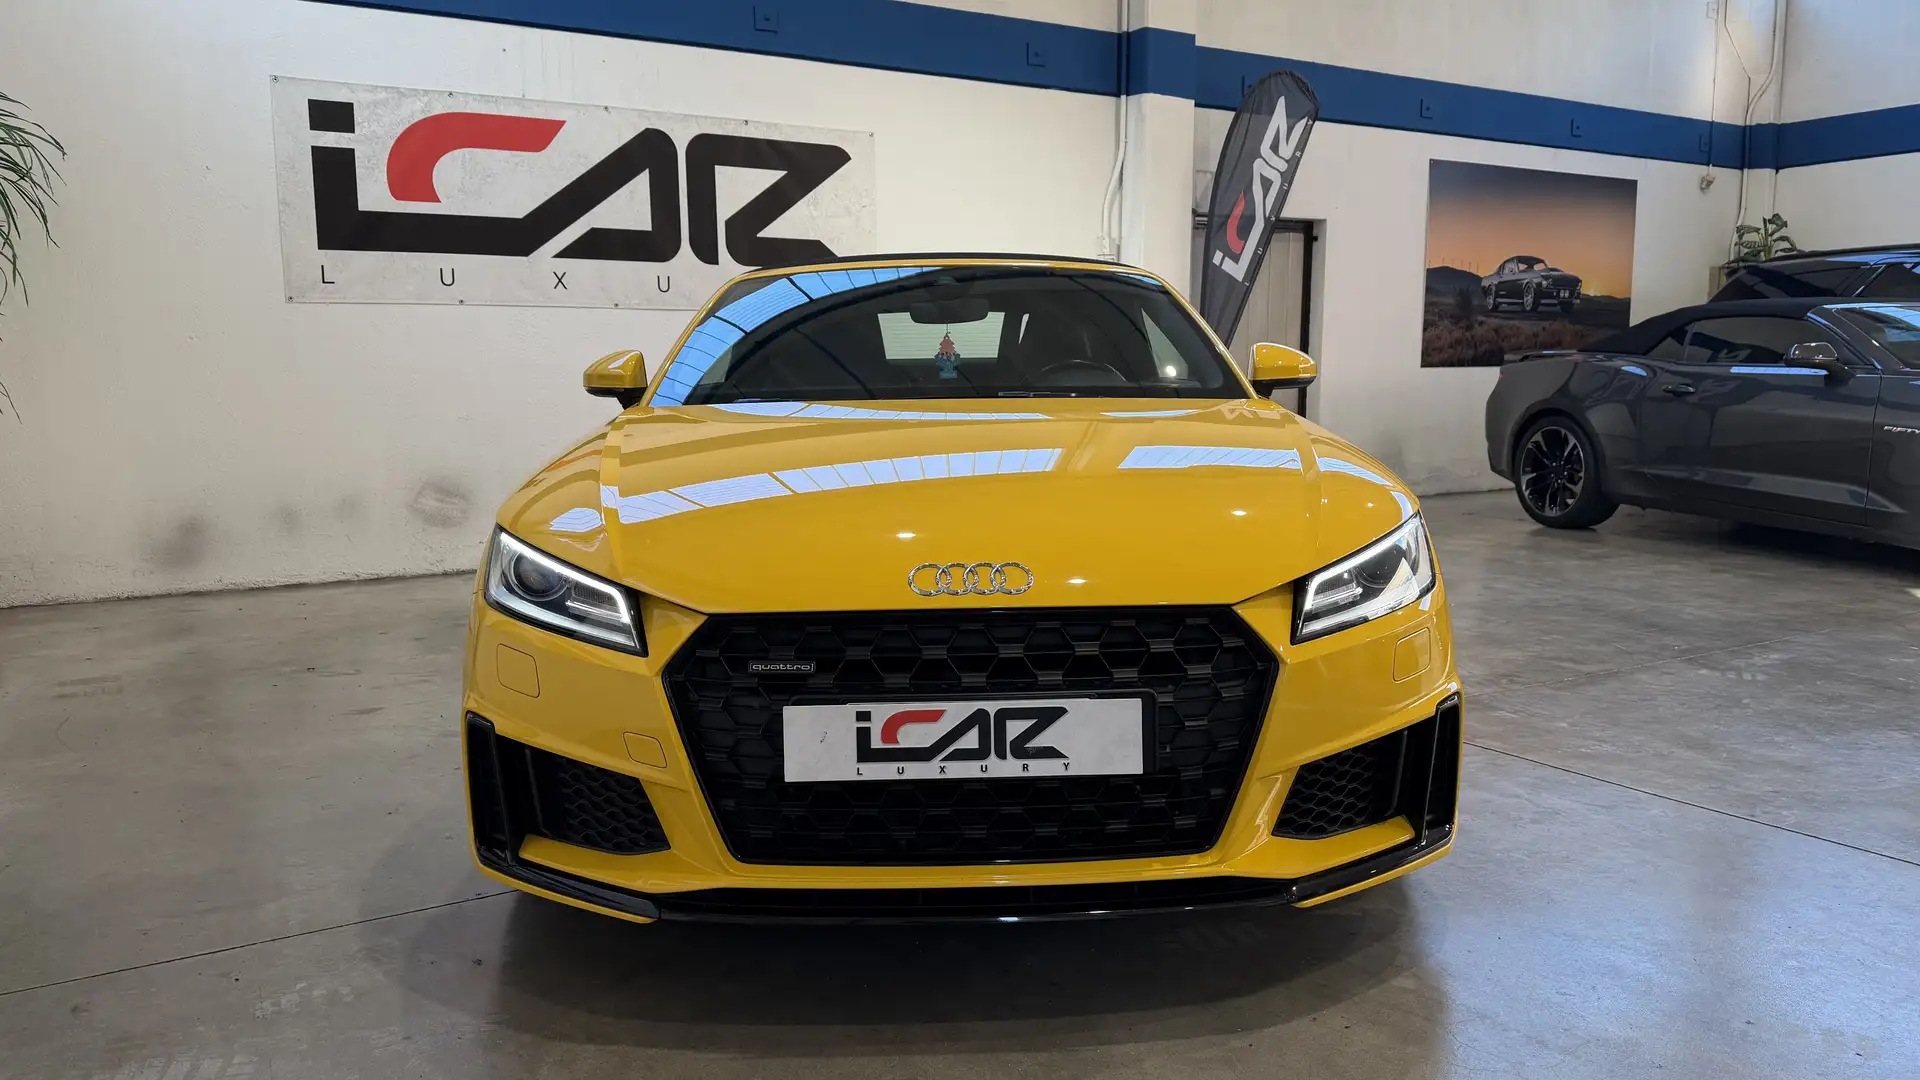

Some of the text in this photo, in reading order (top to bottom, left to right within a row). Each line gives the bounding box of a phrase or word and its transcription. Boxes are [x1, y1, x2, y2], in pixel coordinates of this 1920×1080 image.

[321, 264, 671, 293] LUXU
[752, 663, 812, 671] quattro
[857, 762, 1069, 776] LUXURY
